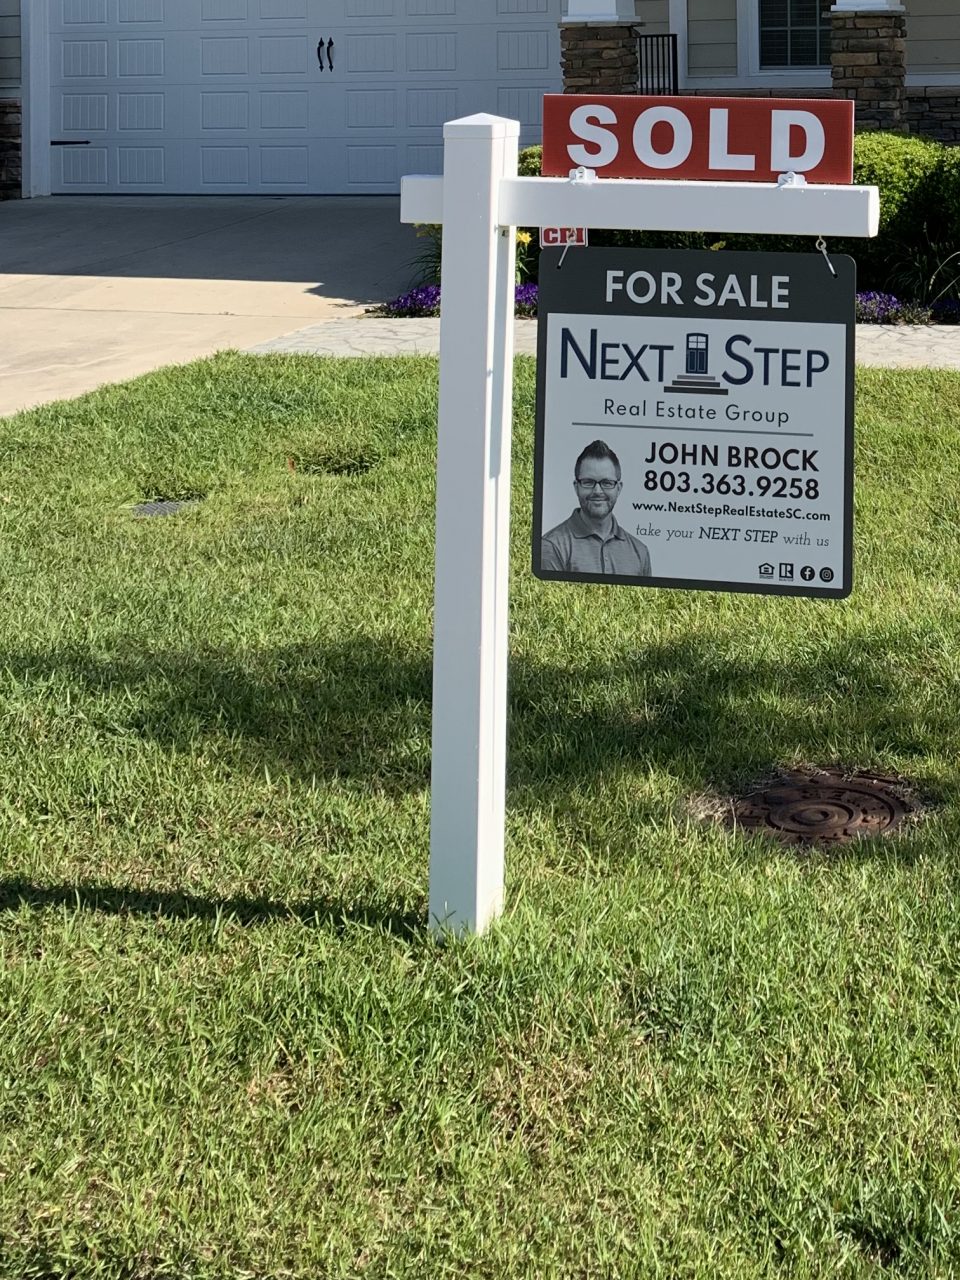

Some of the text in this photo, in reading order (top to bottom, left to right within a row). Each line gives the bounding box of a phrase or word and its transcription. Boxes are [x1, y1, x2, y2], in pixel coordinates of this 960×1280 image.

[566, 103, 826, 173] SOLD
[605, 270, 790, 309] FOR SALE
[560, 327, 830, 388] NEXT STEP
[604, 398, 790, 428] Real Estate Group
[644, 442, 820, 472] JOHN BROCK
[643, 470, 820, 500] 803.363.9258
[632, 502, 831, 521] www.NextStepRealEstateSC.com
[635, 522, 830, 547] take your NEXT STEP with us
